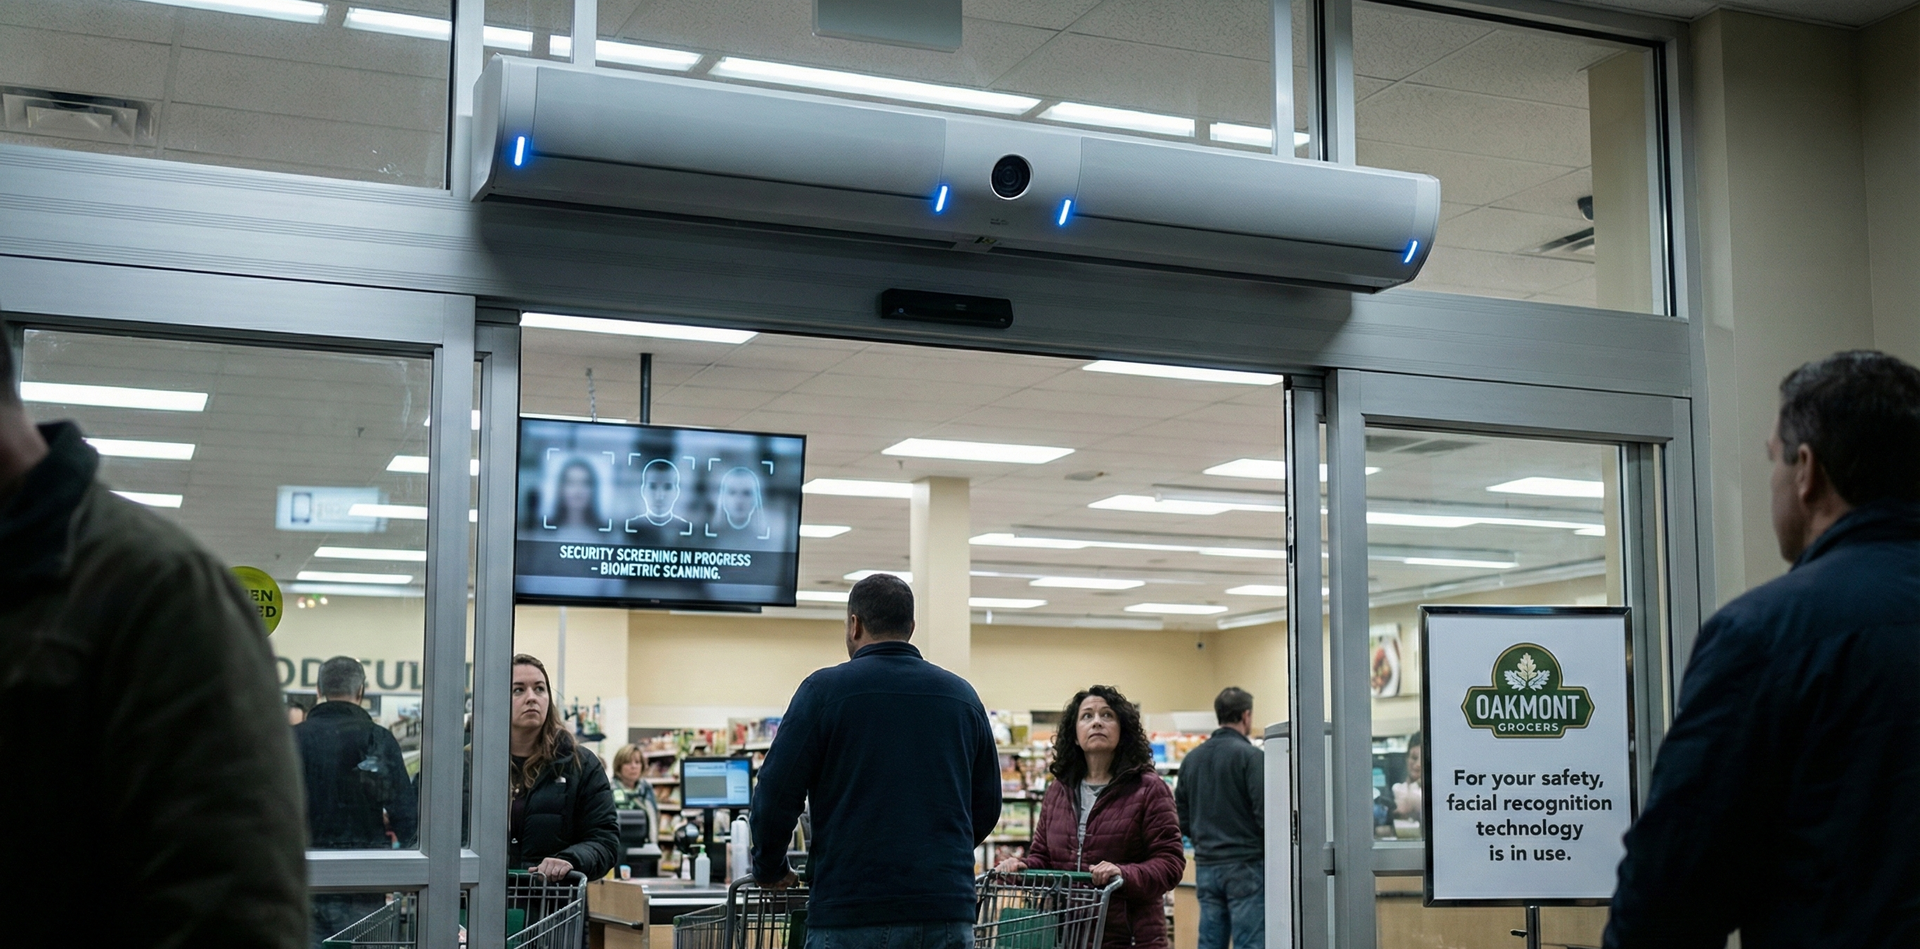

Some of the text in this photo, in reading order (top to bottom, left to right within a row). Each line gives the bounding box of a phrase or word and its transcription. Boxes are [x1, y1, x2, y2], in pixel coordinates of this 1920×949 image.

[559, 545, 752, 567] SECURITY SCREENING IN PROGRESS
[600, 562, 661, 577] BIOMETRIC
[662, 565, 721, 580] SCANNING.
[246, 589, 273, 602] EN
[1476, 694, 1580, 720] OAKMONT
[1497, 722, 1559, 732] GROCERS
[1454, 768, 1604, 790] For your safety,
[1446, 793, 1613, 815] facial recognition
[1476, 818, 1584, 841] technology
[1489, 844, 1572, 861] is in use.
